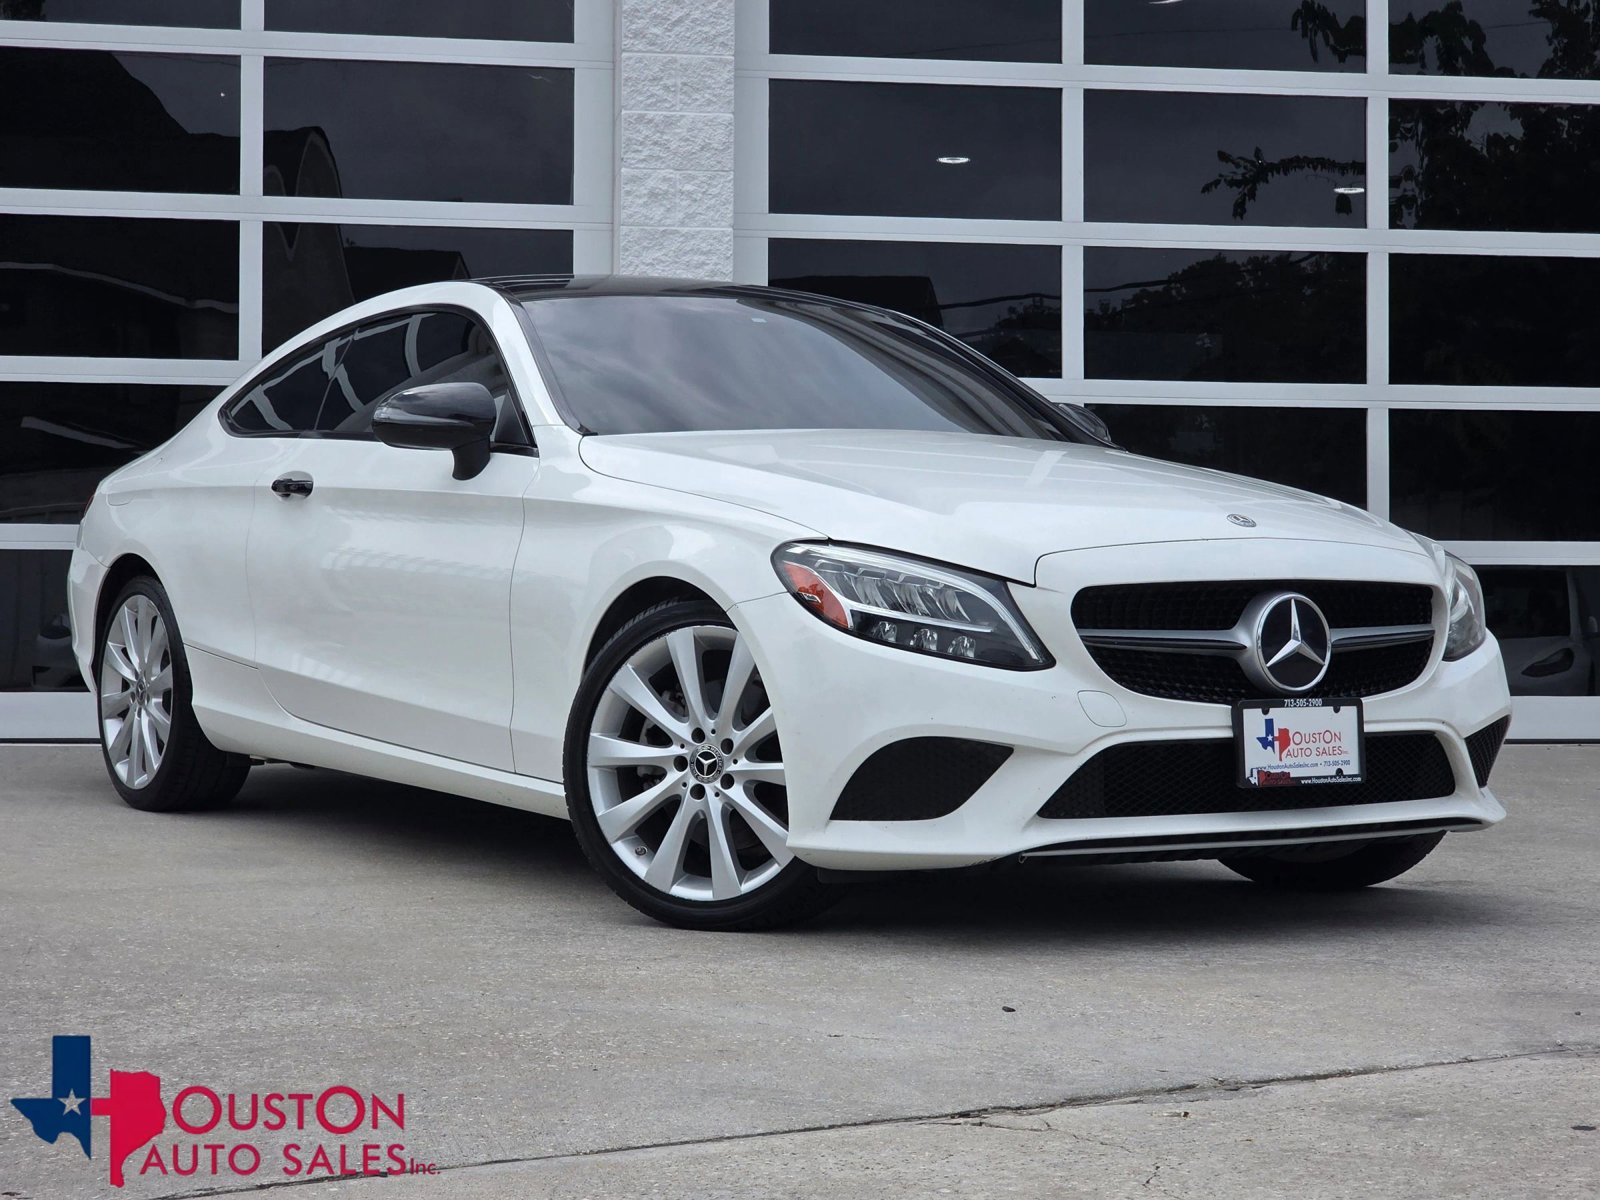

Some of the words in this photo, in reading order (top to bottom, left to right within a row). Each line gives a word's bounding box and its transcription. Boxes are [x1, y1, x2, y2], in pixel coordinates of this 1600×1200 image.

[1284, 699, 1322, 707] 713-505-2900
[1286, 747, 1312, 758] AUTO
[1315, 746, 1342, 757] SALES
